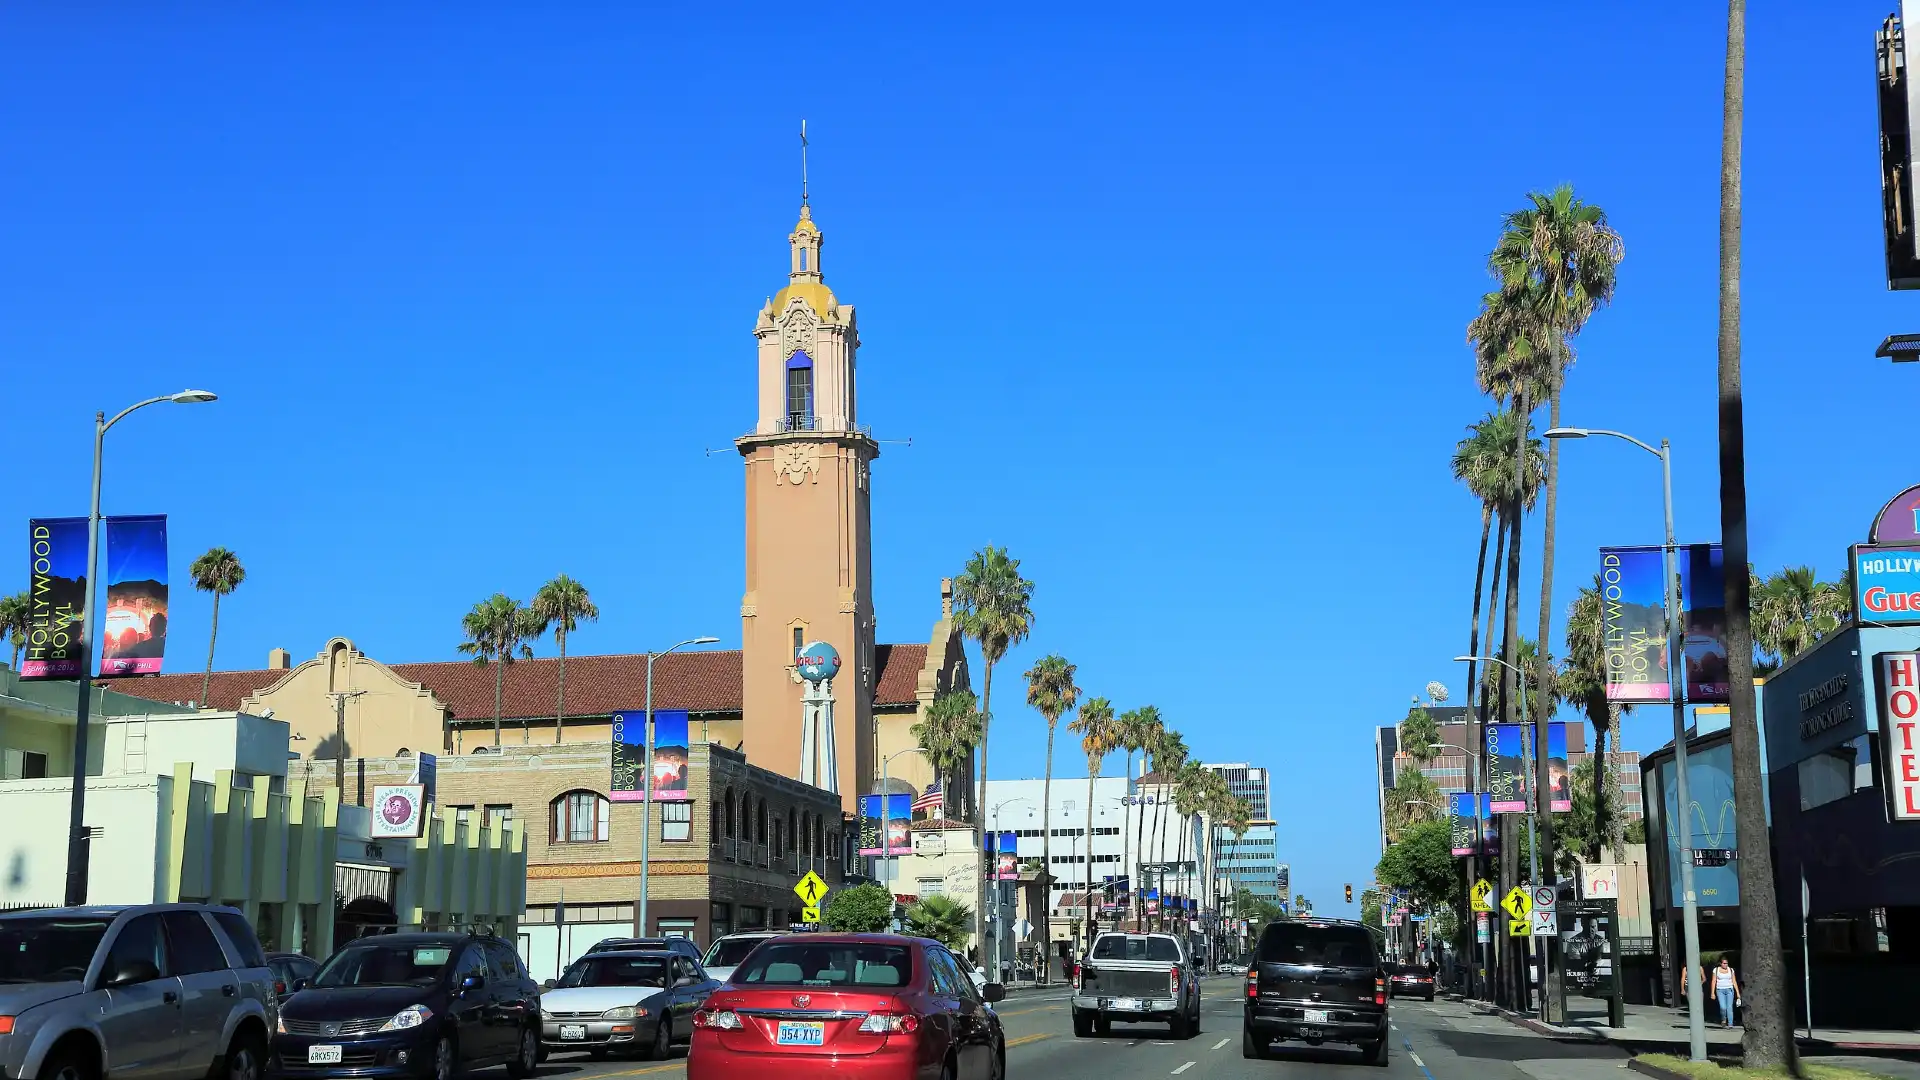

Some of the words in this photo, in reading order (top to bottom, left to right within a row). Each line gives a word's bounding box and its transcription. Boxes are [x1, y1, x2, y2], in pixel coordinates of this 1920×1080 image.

[29, 526, 51, 660] HOLLYWOOD
[1604, 554, 1625, 683] HOLLYWOOD
[51, 602, 72, 659] BOWL
[1630, 627, 1648, 683] BOWL
[27, 664, 56, 672] SUMMER
[57, 663, 75, 671] 2012
[613, 714, 624, 791] HOLLYWOOD
[1488, 727, 1501, 801] HOLLYWOOD
[1889, 659, 1920, 814] HOTEL
[395, 788, 418, 808] PREVIEW
[624, 758, 635, 791] BOWL
[1503, 771, 1514, 801] BOWL
[1451, 794, 1461, 849] HOLLYWOOD
[1461, 825, 1470, 849] BOWL
